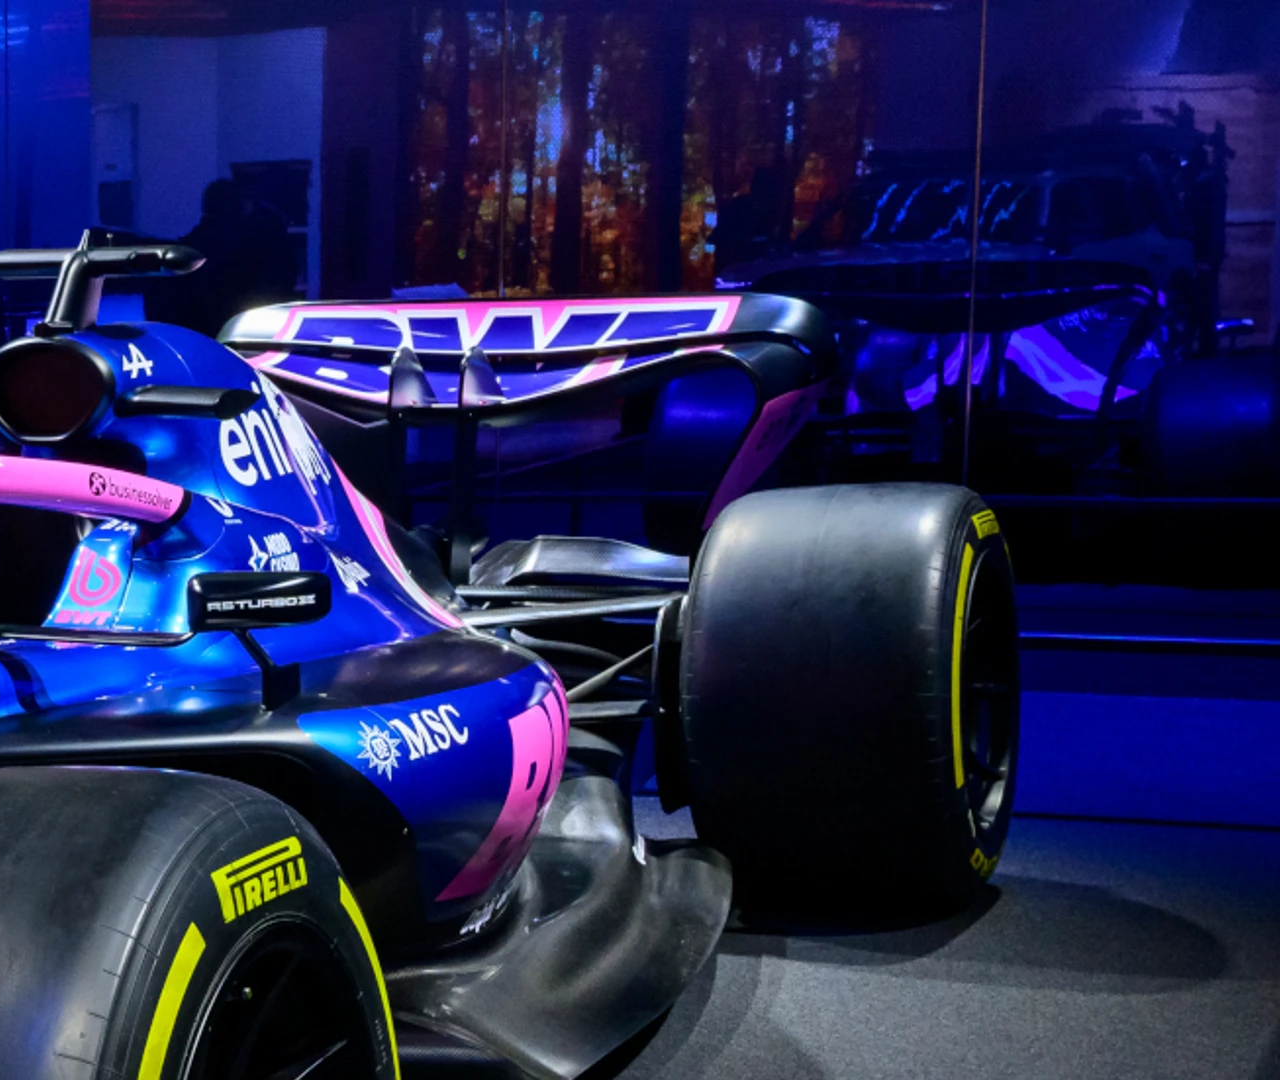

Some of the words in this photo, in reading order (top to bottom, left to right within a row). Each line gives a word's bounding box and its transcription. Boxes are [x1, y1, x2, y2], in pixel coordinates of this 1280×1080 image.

[219, 381, 293, 487] eni
[108, 479, 173, 510] businessolver
[53, 609, 111, 626] BWT
[387, 704, 469, 761] MSC
[210, 835, 308, 924] PIRELLI
